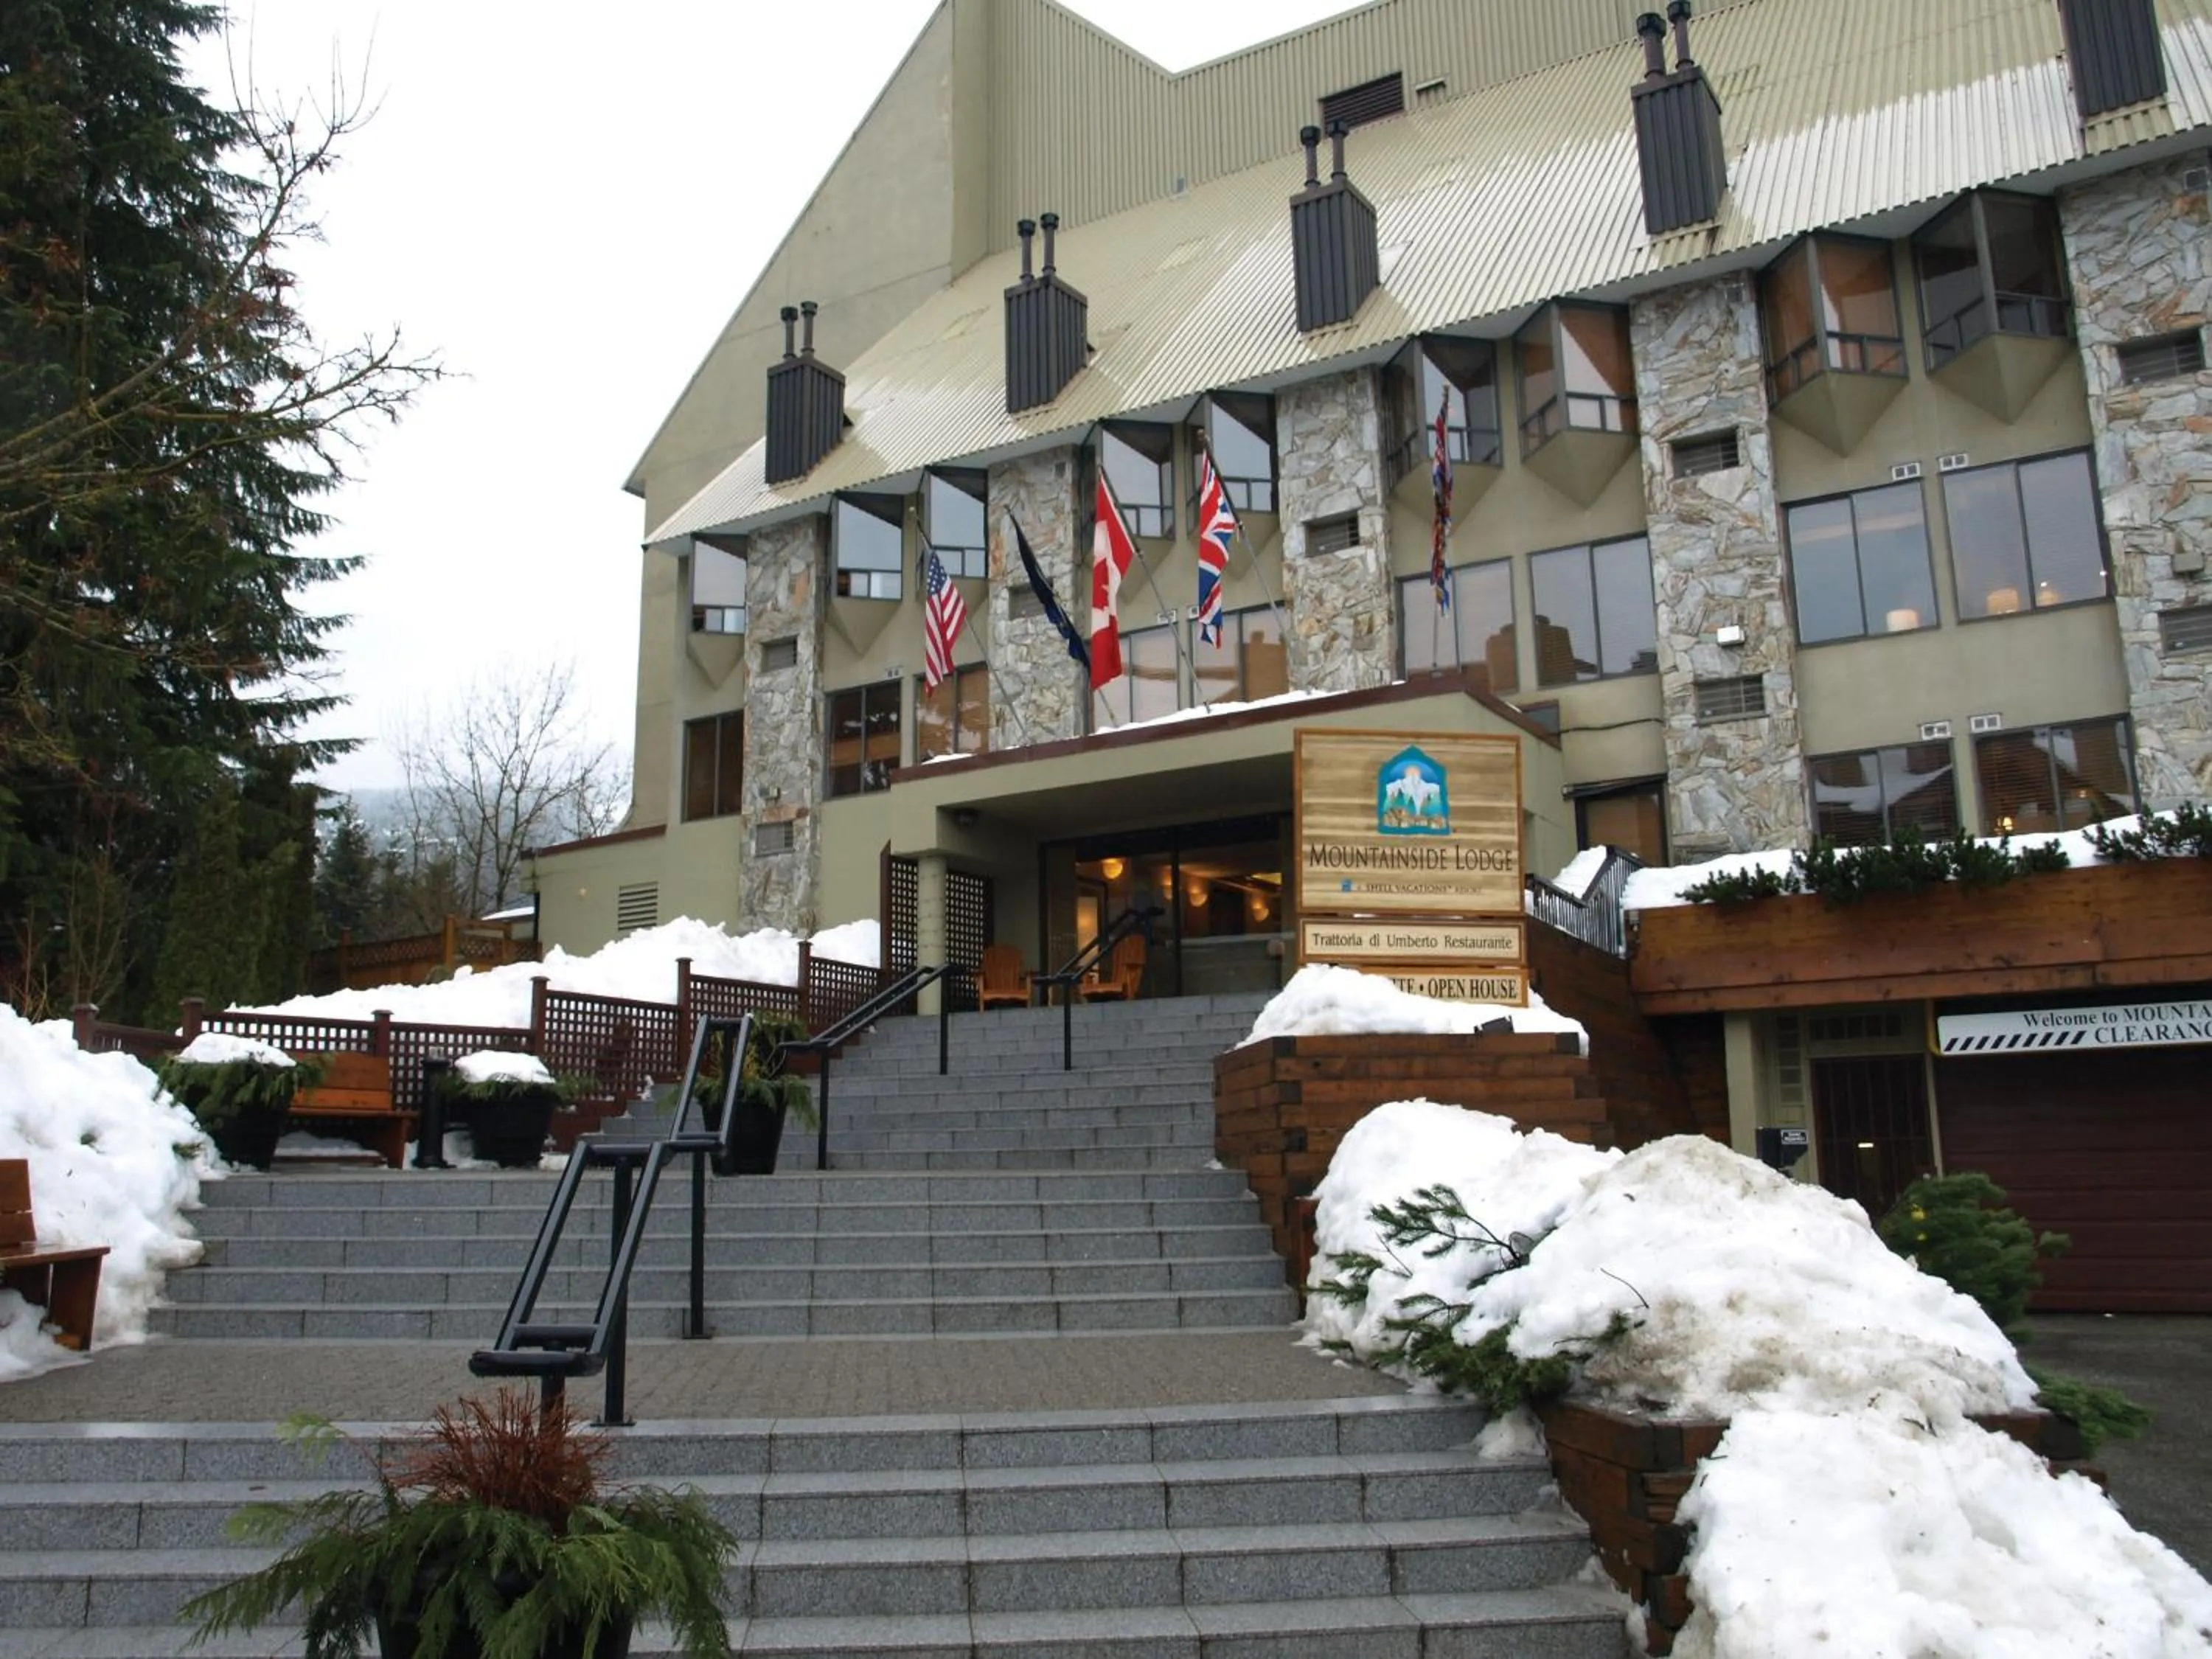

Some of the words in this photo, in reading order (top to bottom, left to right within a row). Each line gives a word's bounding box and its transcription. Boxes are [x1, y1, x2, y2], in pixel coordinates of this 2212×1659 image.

[1310, 844, 1447, 870] MOUNTAINSIDE
[1455, 844, 1513, 872] LODGE
[1312, 933, 1363, 947] Trattoria
[1369, 933, 1380, 947] di
[1387, 935, 1438, 948] Umberto
[1444, 936, 1512, 950] Restaurante
[1428, 978, 1464, 998] OPEN
[1469, 978, 1517, 998] HOUSE
[2023, 1012, 2097, 1027] Welcome
[2102, 1012, 2118, 1023] to
